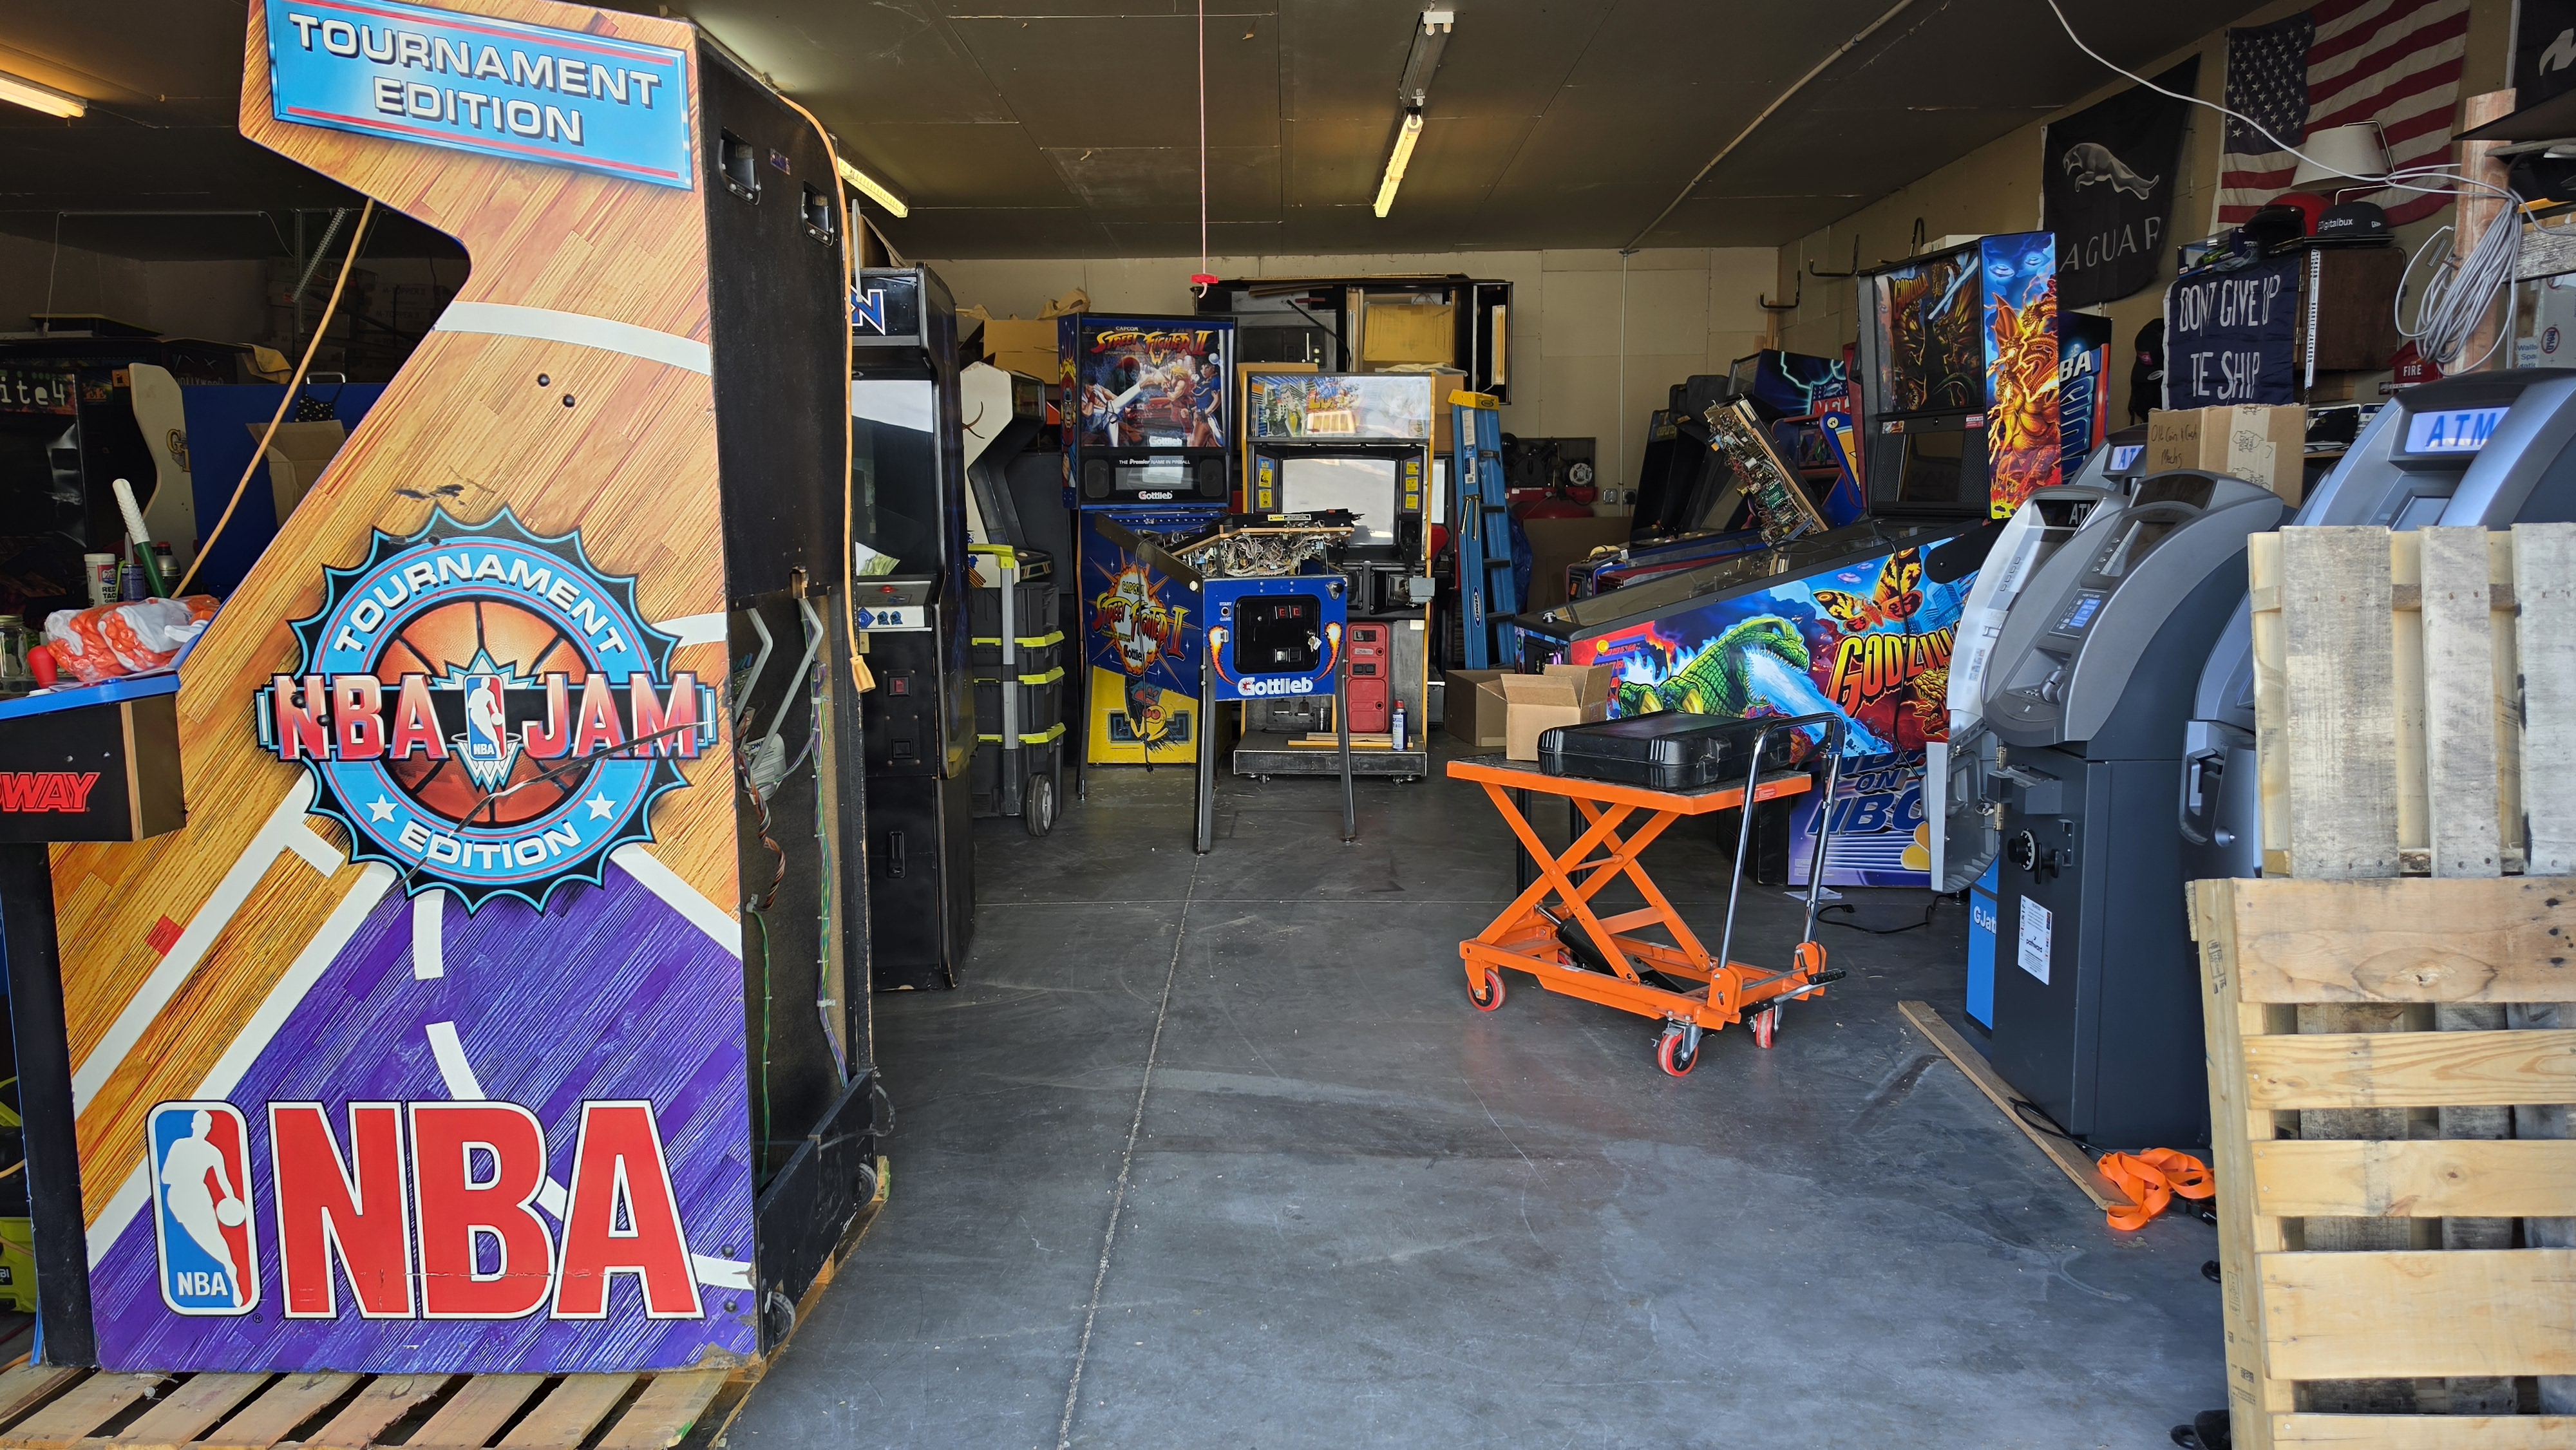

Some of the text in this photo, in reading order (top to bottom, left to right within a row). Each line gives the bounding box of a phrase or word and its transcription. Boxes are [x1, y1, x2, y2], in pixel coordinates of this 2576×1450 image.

[289, 12, 662, 109] TOURNAMENT
[372, 77, 584, 146] EDITION
[2059, 216, 2161, 272] AGUAR
[1893, 271, 1929, 320] GODZILLA
[2219, 279, 2259, 326] GIVE
[1090, 330, 1147, 353] STREET
[1143, 331, 1193, 355] FIGHTER
[2060, 350, 2092, 382] BA
[2217, 350, 2260, 400] SHIP
[2403, 364, 2422, 377] FIRE
[2425, 412, 2497, 447] ATM
[2117, 447, 2142, 469] AT
[1139, 491, 1173, 500] Gottlieb
[333, 552, 627, 655] TOURNAMENT
[1092, 592, 1133, 632] STREET
[1238, 677, 1313, 696] Gottlieb
[1828, 628, 1955, 717] GODZILL
[273, 672, 702, 761] NBA JAM
[472, 743, 495, 756] NBA
[0, 771, 100, 813] WAY
[1855, 767, 1908, 793] ON
[397, 818, 582, 871] EDITION
[267, 1100, 707, 1321] NBA
[177, 1270, 229, 1297] NBA
